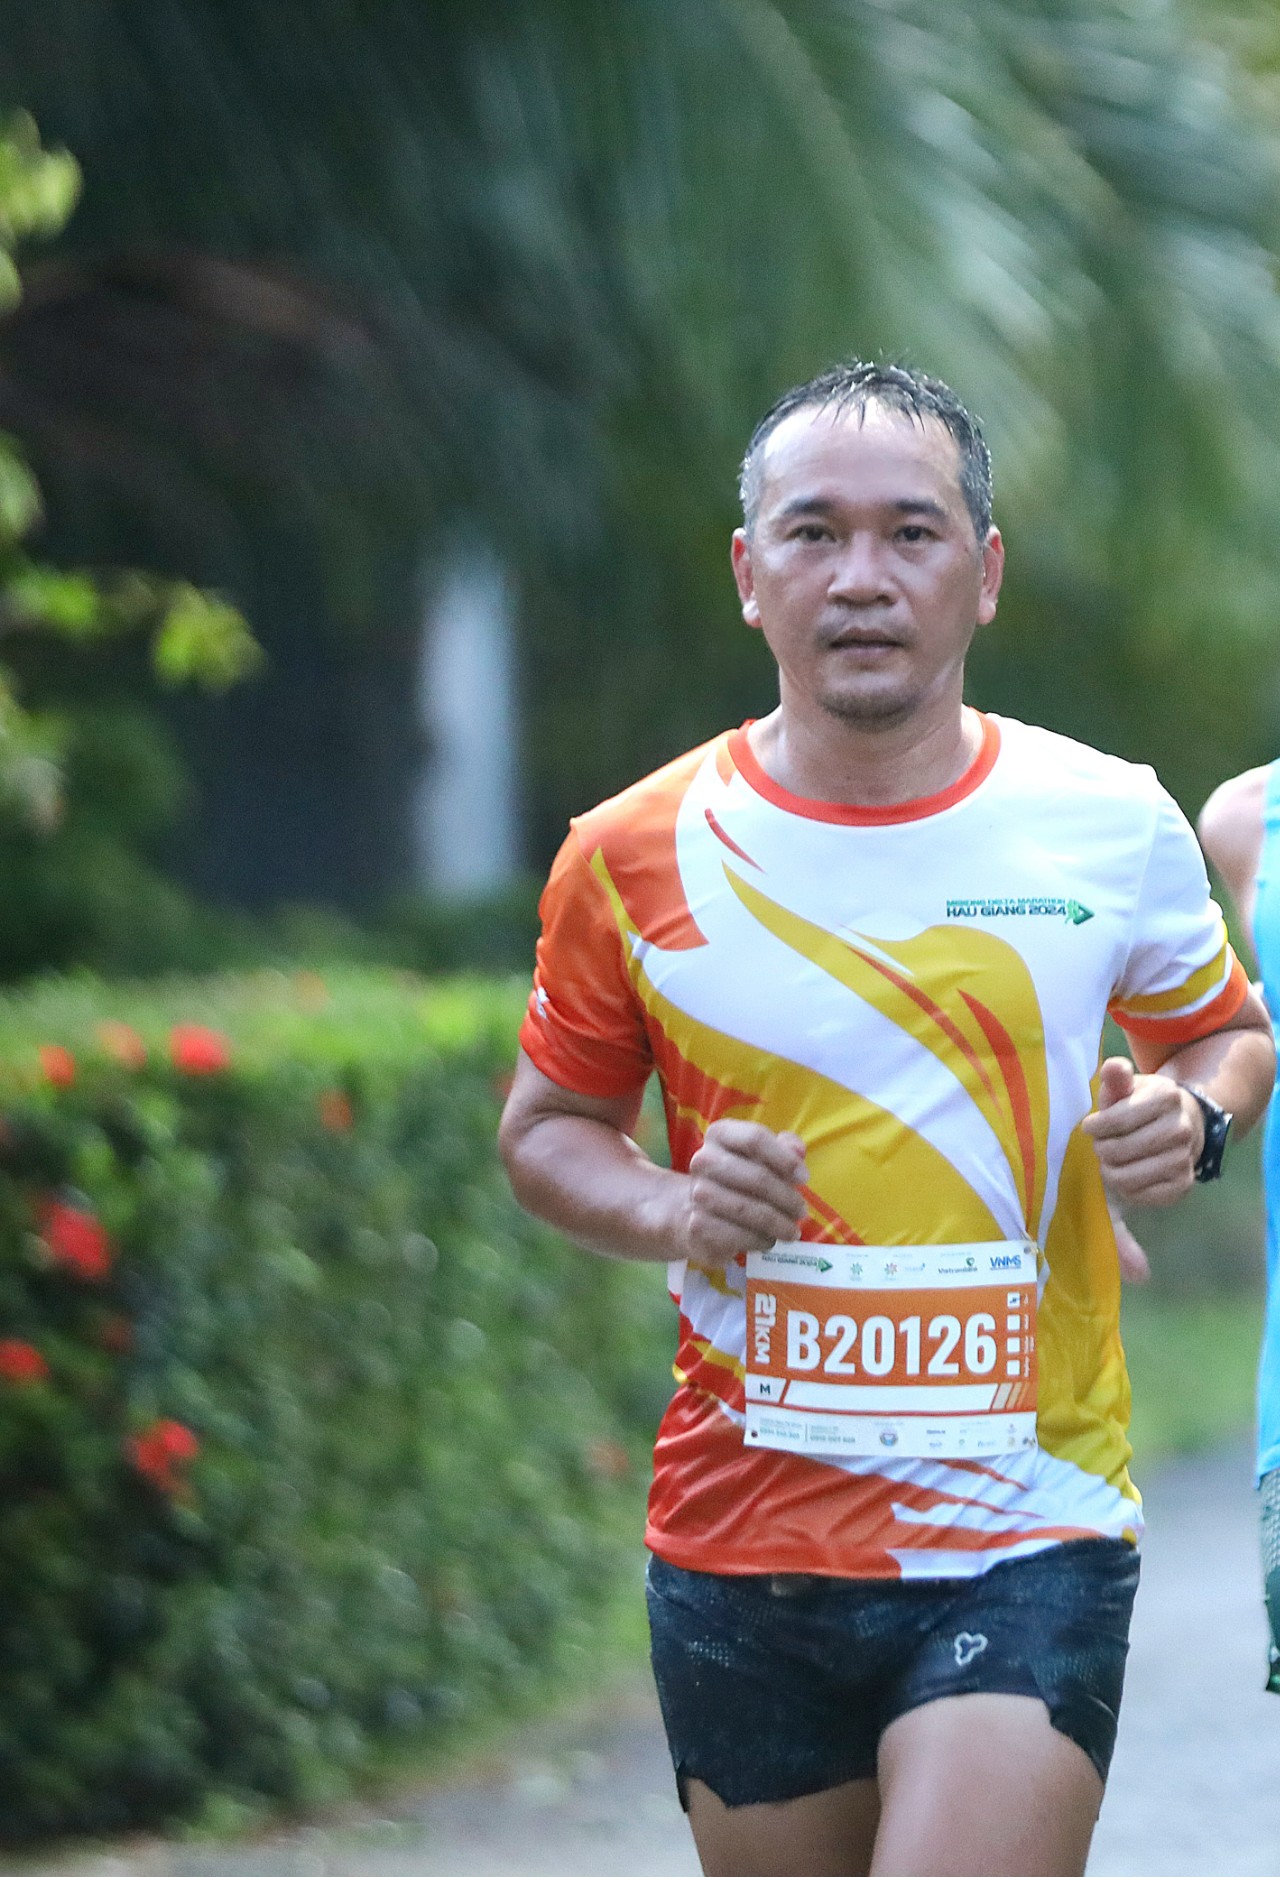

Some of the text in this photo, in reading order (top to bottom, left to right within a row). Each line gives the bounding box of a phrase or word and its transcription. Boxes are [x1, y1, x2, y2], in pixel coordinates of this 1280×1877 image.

[980, 905, 1026, 916] GIANG
[1028, 904, 1067, 916] 2024
[989, 1254, 1022, 1268] VNMS
[755, 1293, 777, 1364] 21KM
[786, 1310, 997, 1376] B20126
[759, 1383, 771, 1395] M
